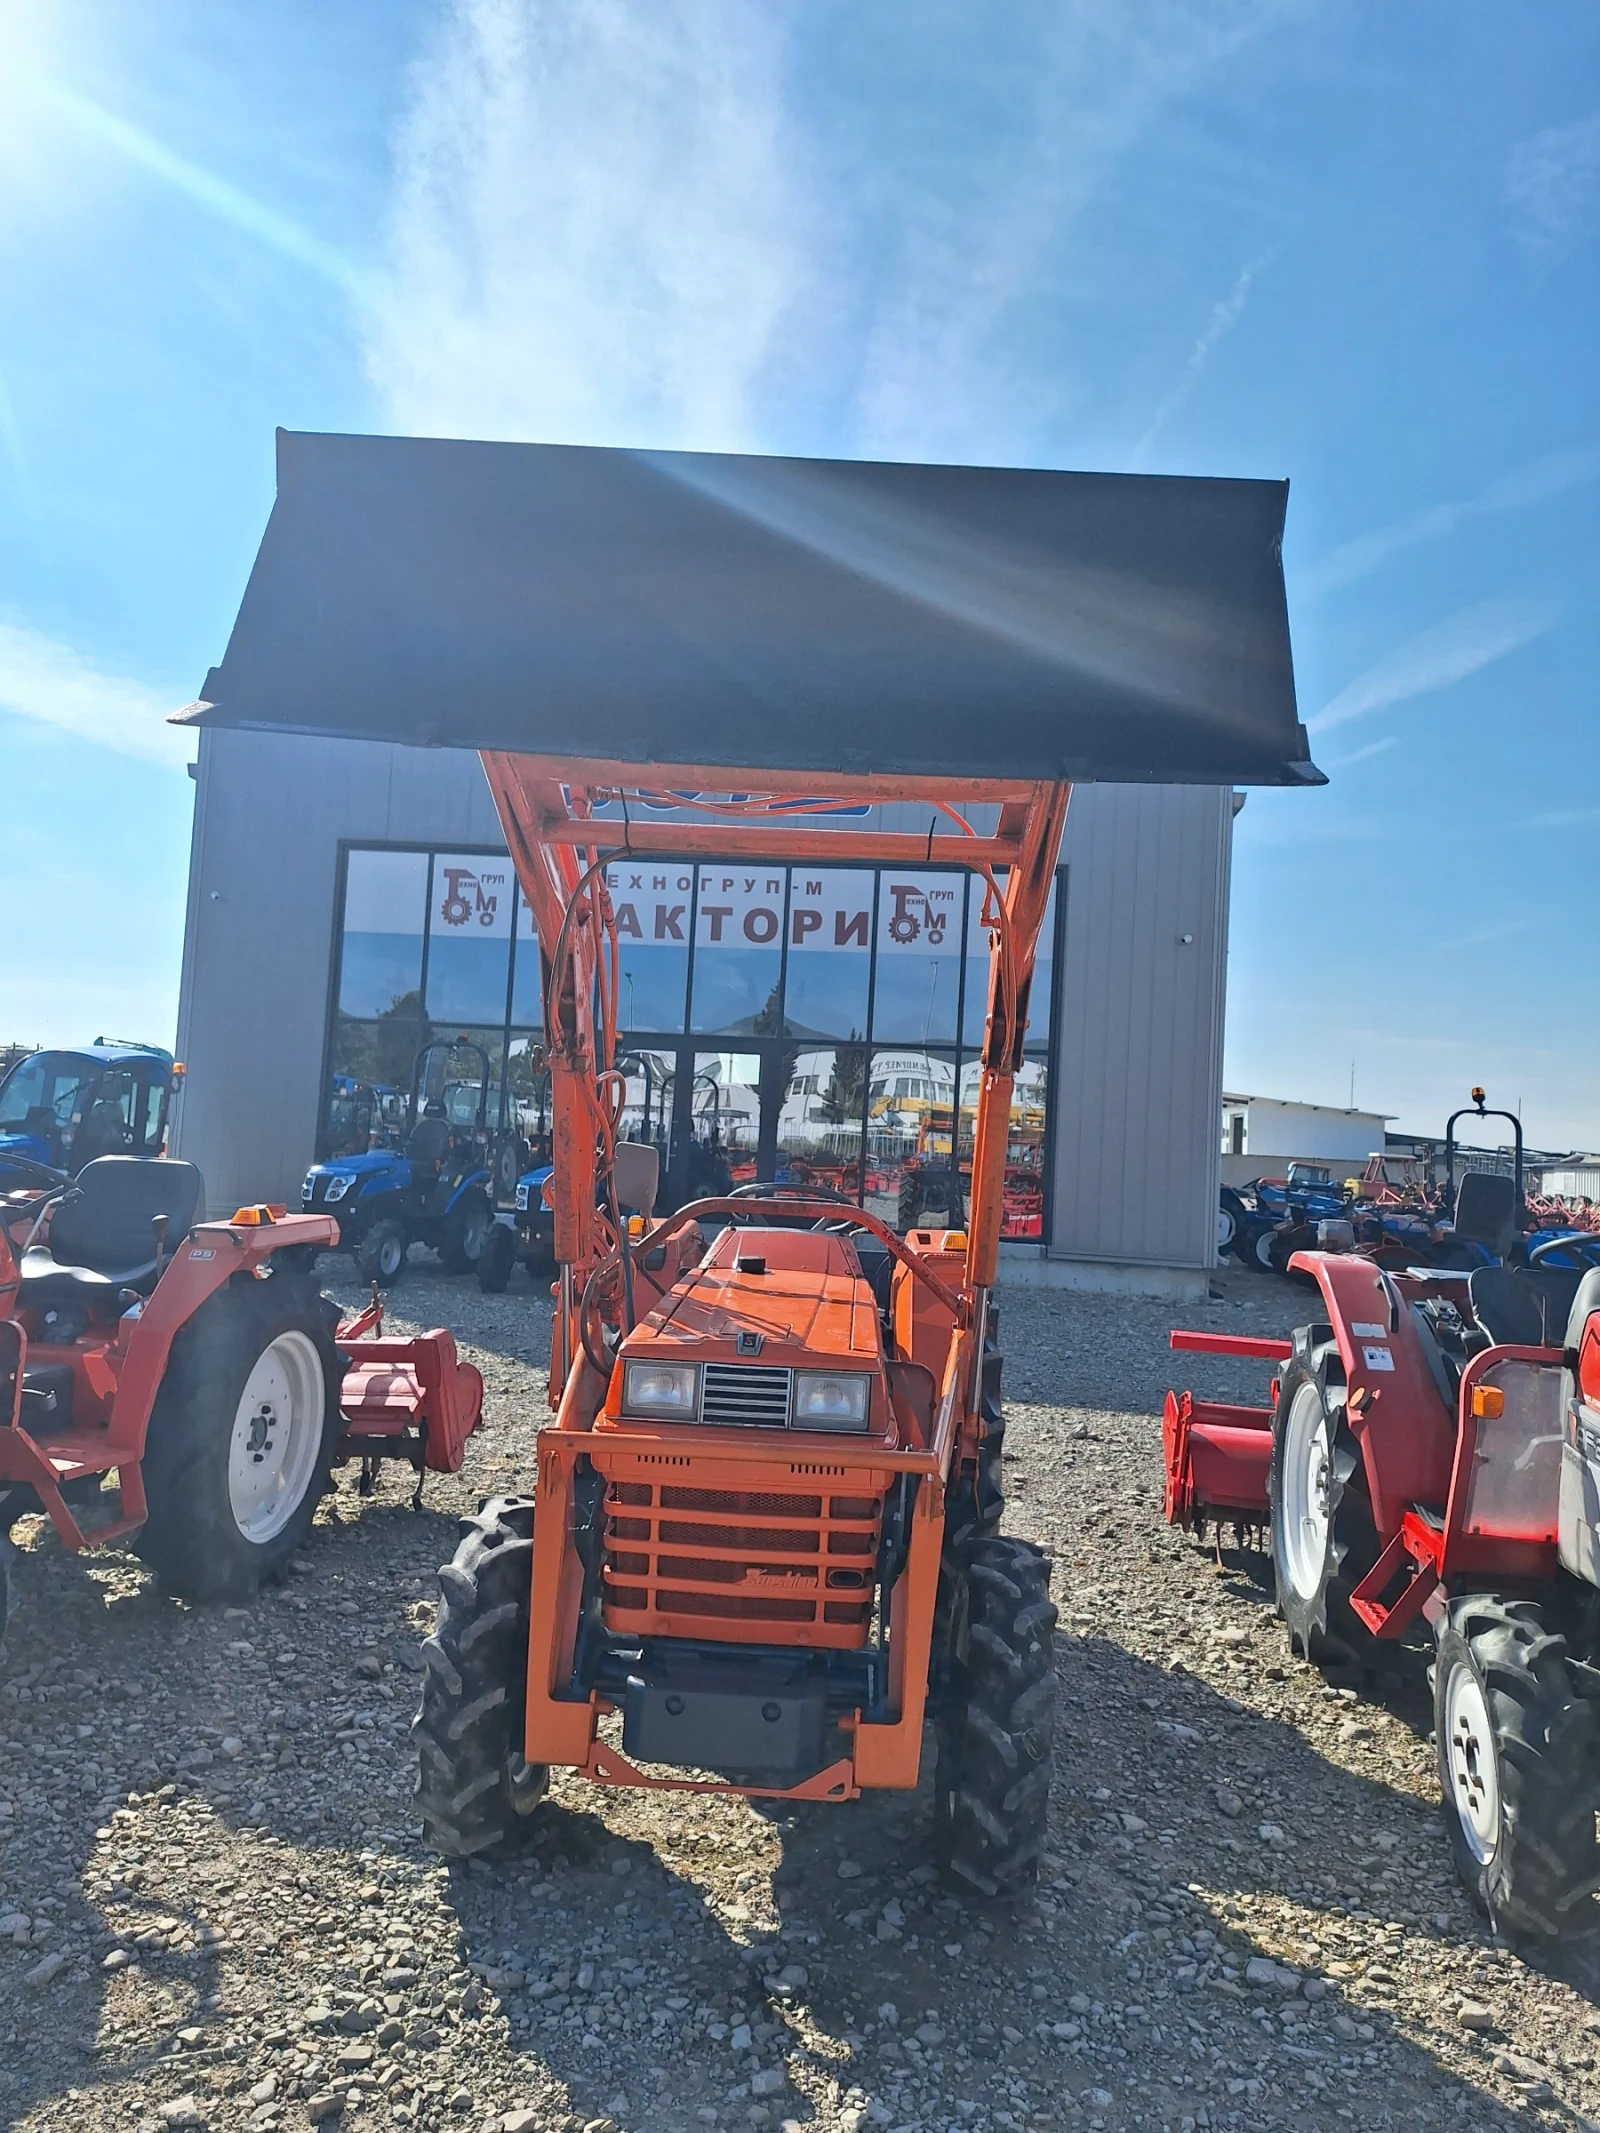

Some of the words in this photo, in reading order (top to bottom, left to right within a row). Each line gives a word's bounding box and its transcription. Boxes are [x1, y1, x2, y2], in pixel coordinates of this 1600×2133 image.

[481, 874, 505, 885] ГРУП
[607, 874, 822, 896] ЕХНОГРУП-М
[929, 890, 954, 901] ГРУП
[523, 899, 869, 946] АКТОРИ
